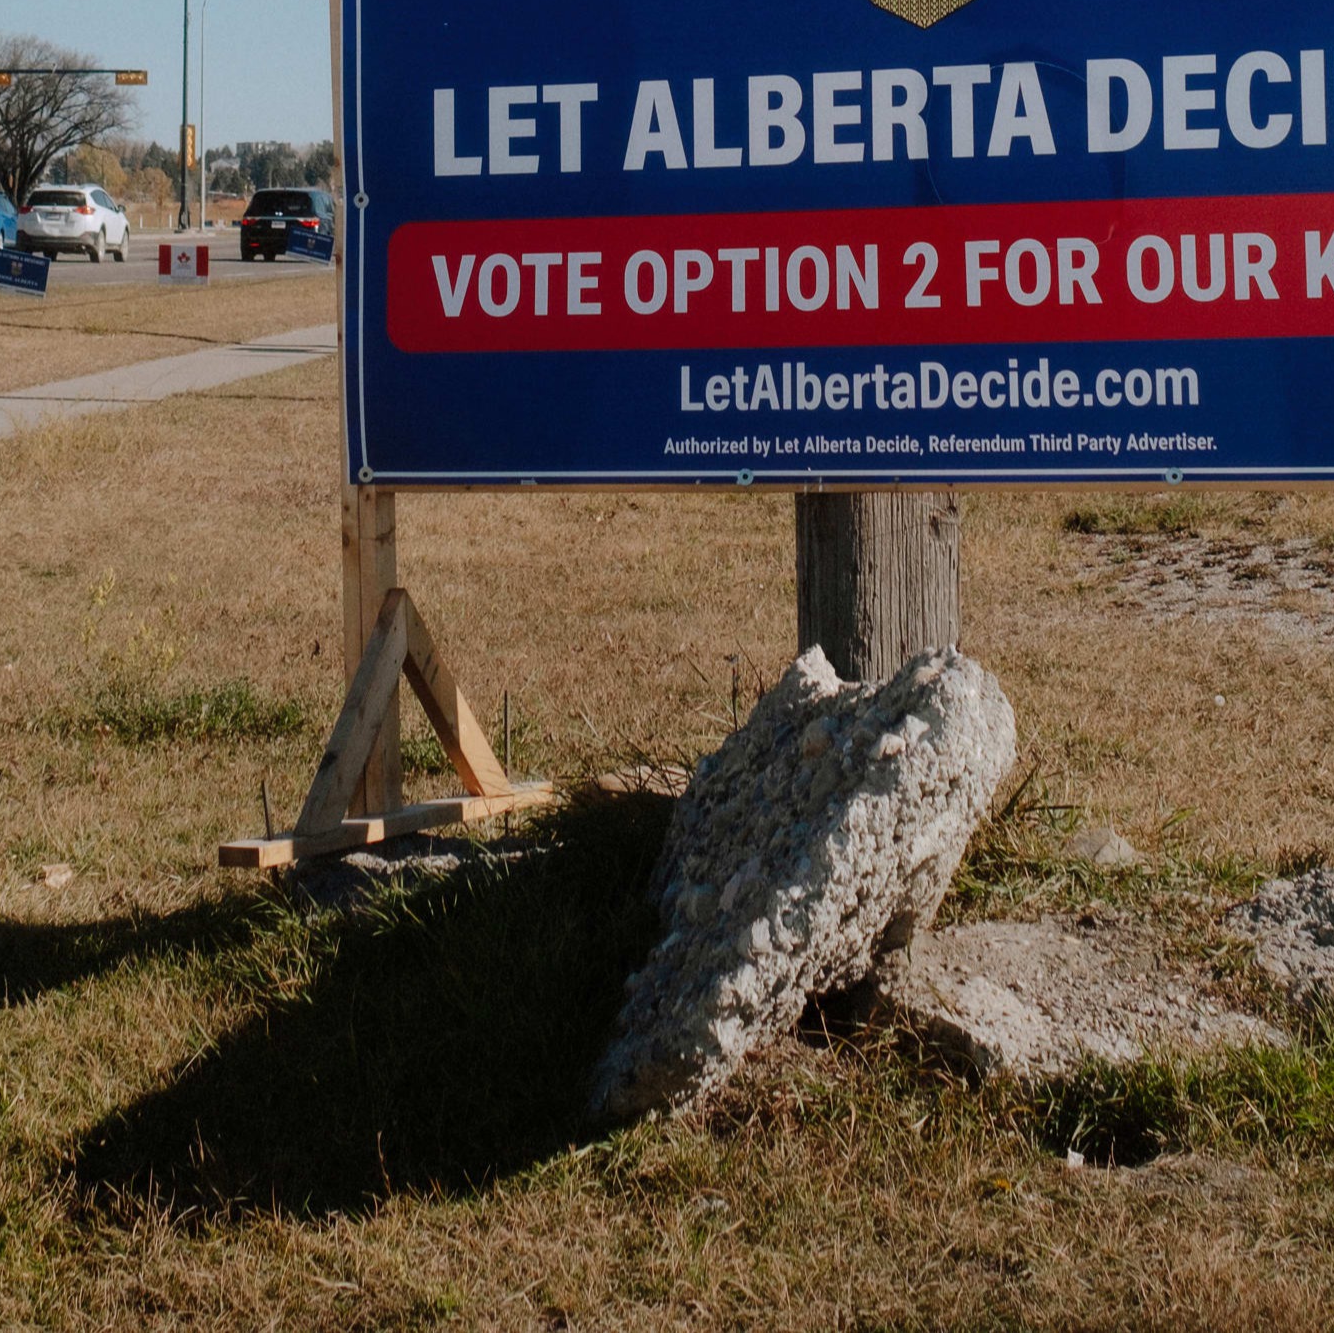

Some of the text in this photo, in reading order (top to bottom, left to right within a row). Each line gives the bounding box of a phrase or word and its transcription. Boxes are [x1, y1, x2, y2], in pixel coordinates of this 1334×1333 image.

[433, 82, 598, 177] LET
[623, 61, 1057, 171] ALBERTA
[431, 251, 602, 317] VOTE
[624, 244, 879, 315] OPTION
[902, 241, 941, 309] 2
[964, 237, 1103, 307] FOR
[1126, 232, 1280, 304] OUR
[681, 358, 1200, 412] LetAlbertaDecide.com
[664, 432, 1218, 458] Authorized by Let Alberta Decide, Referendum Third Party Advertiser.
